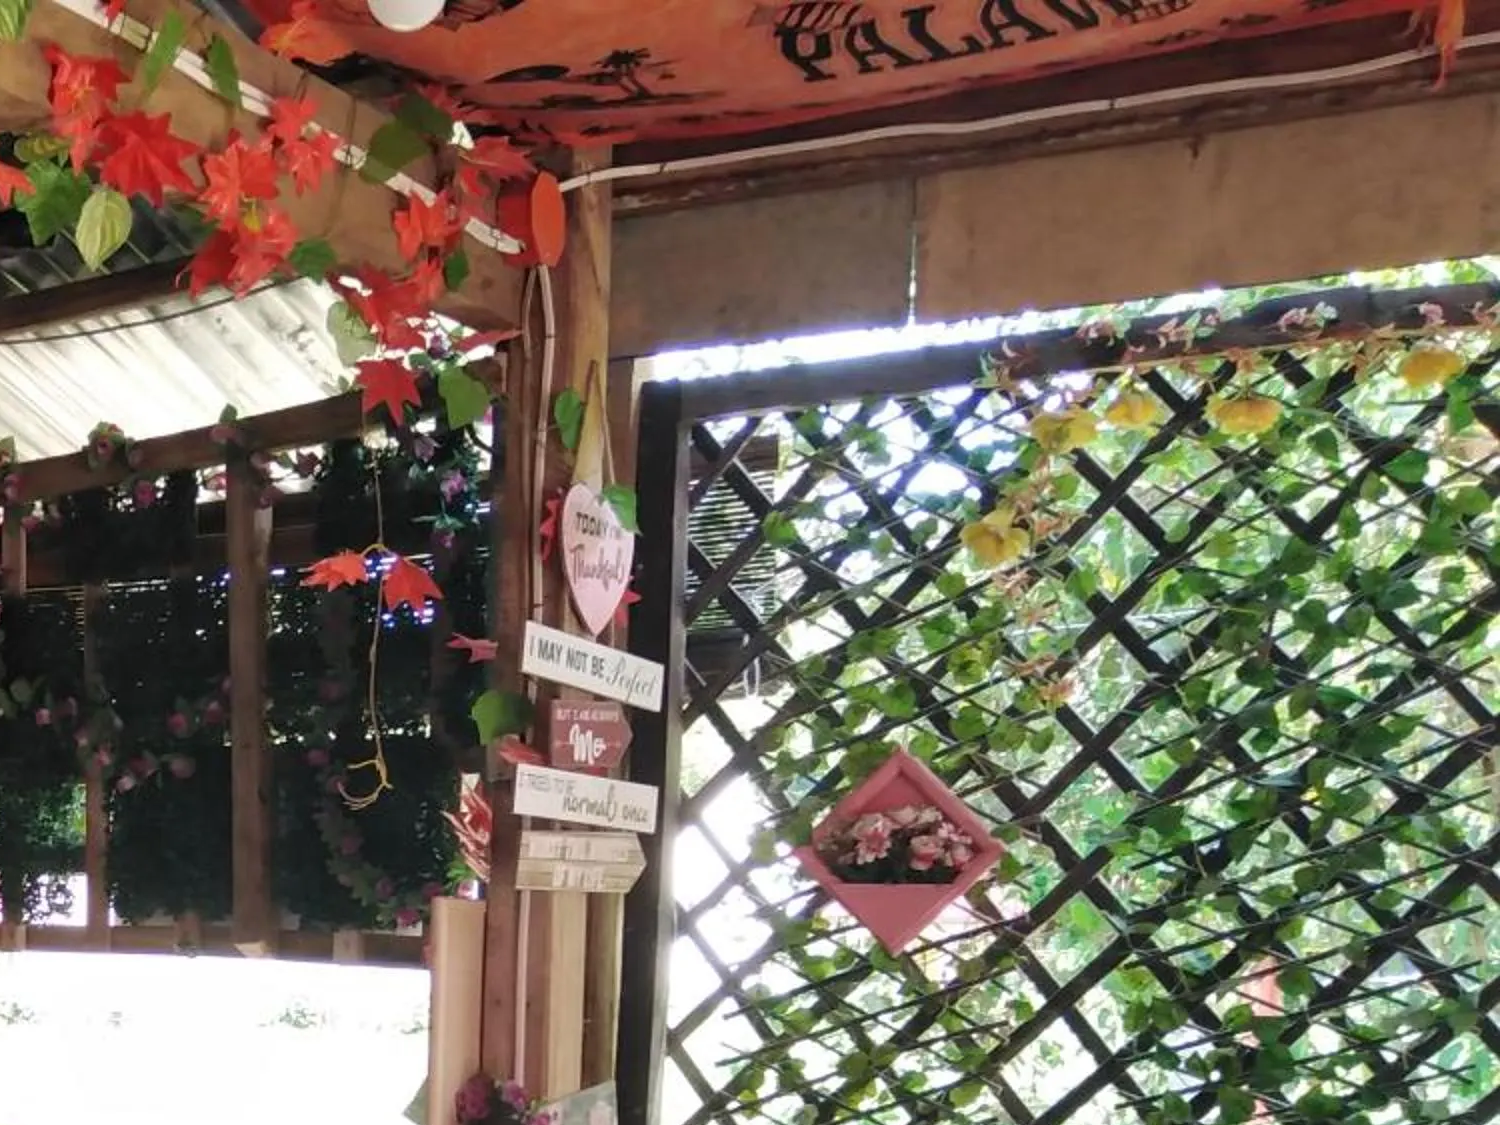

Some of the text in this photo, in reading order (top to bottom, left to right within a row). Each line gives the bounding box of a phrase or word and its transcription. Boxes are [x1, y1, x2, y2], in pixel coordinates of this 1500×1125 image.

[537, 637, 563, 664] MAY
[565, 647, 589, 674] NOT
[590, 655, 606, 680] BE
